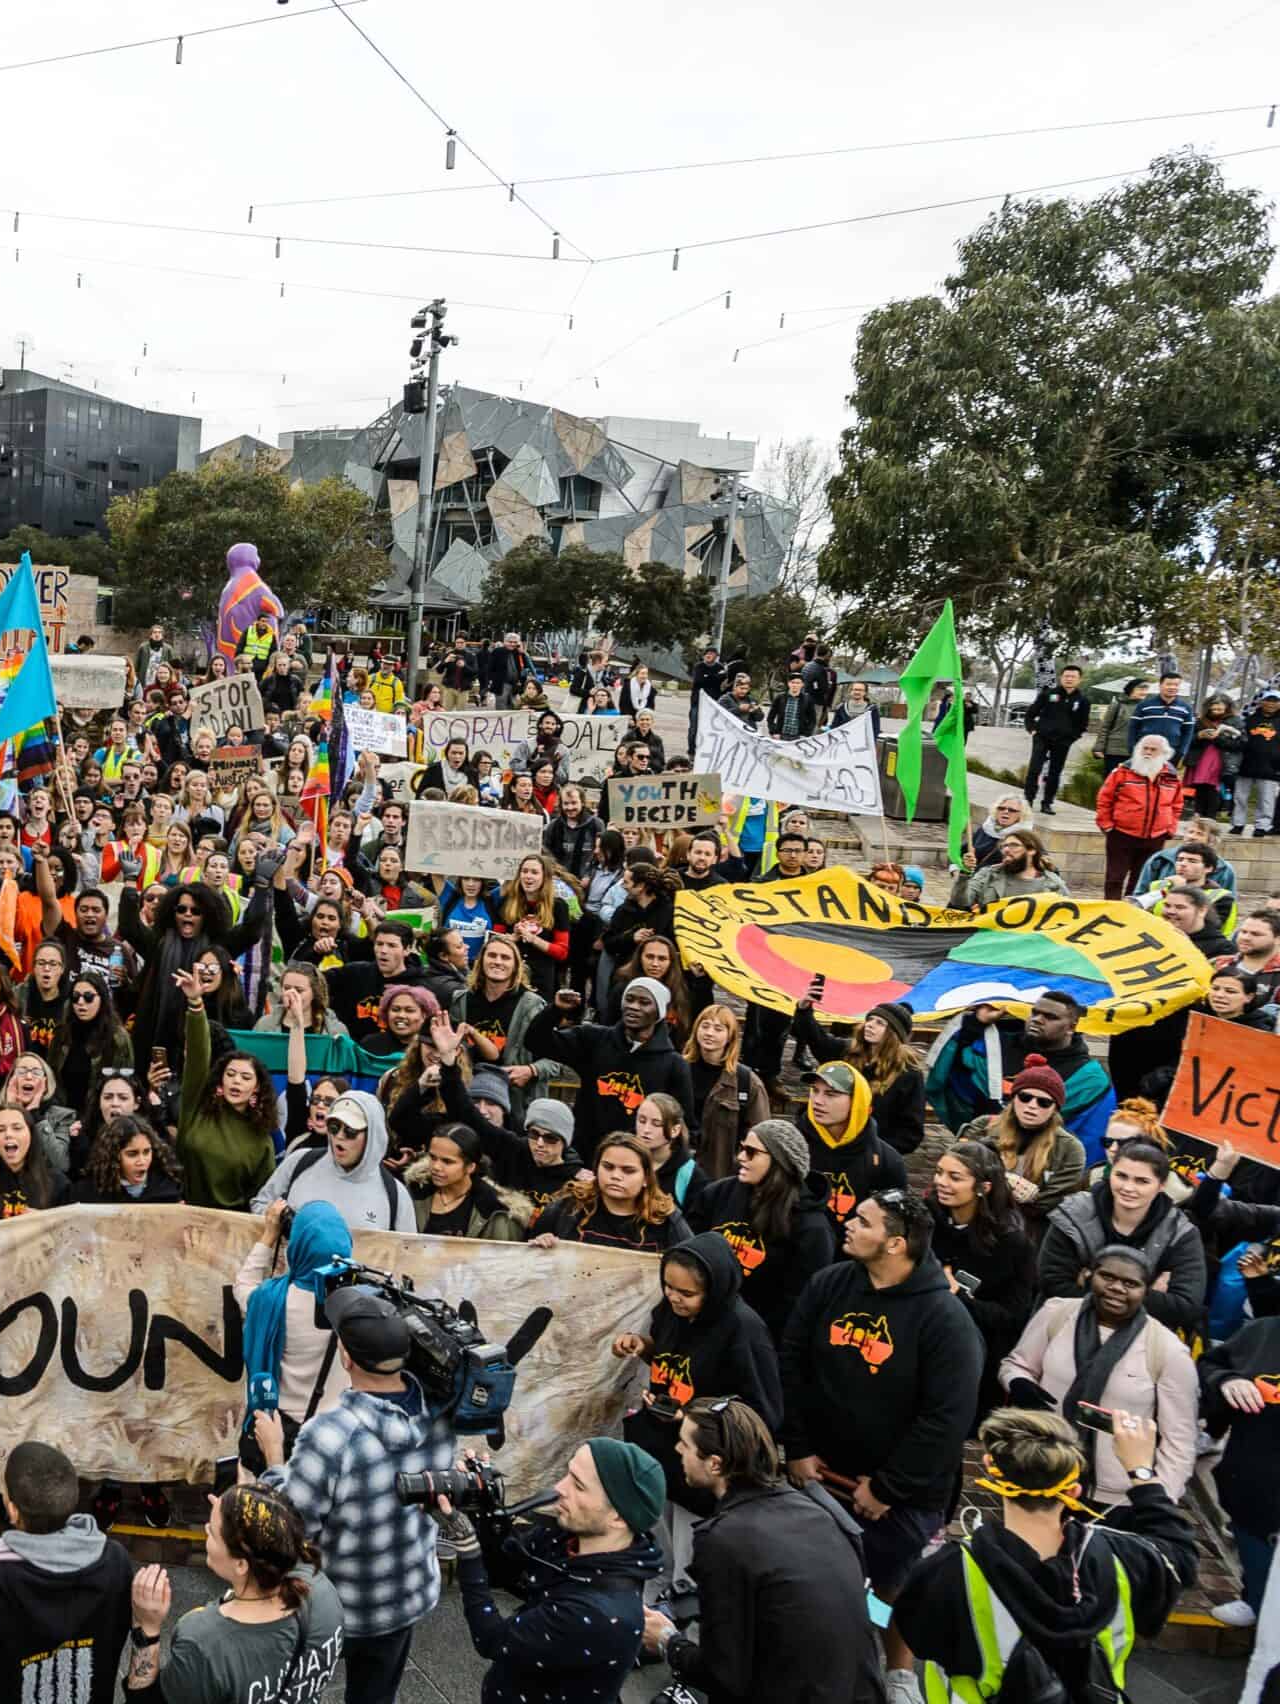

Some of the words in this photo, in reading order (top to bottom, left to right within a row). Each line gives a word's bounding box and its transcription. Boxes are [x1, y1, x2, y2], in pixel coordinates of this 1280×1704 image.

[201, 680, 251, 715] STOP
[429, 716, 523, 748] CORAL
[618, 781, 698, 801] YOUTH
[625, 806, 697, 823] DECIDE
[733, 884, 931, 926] STAND
